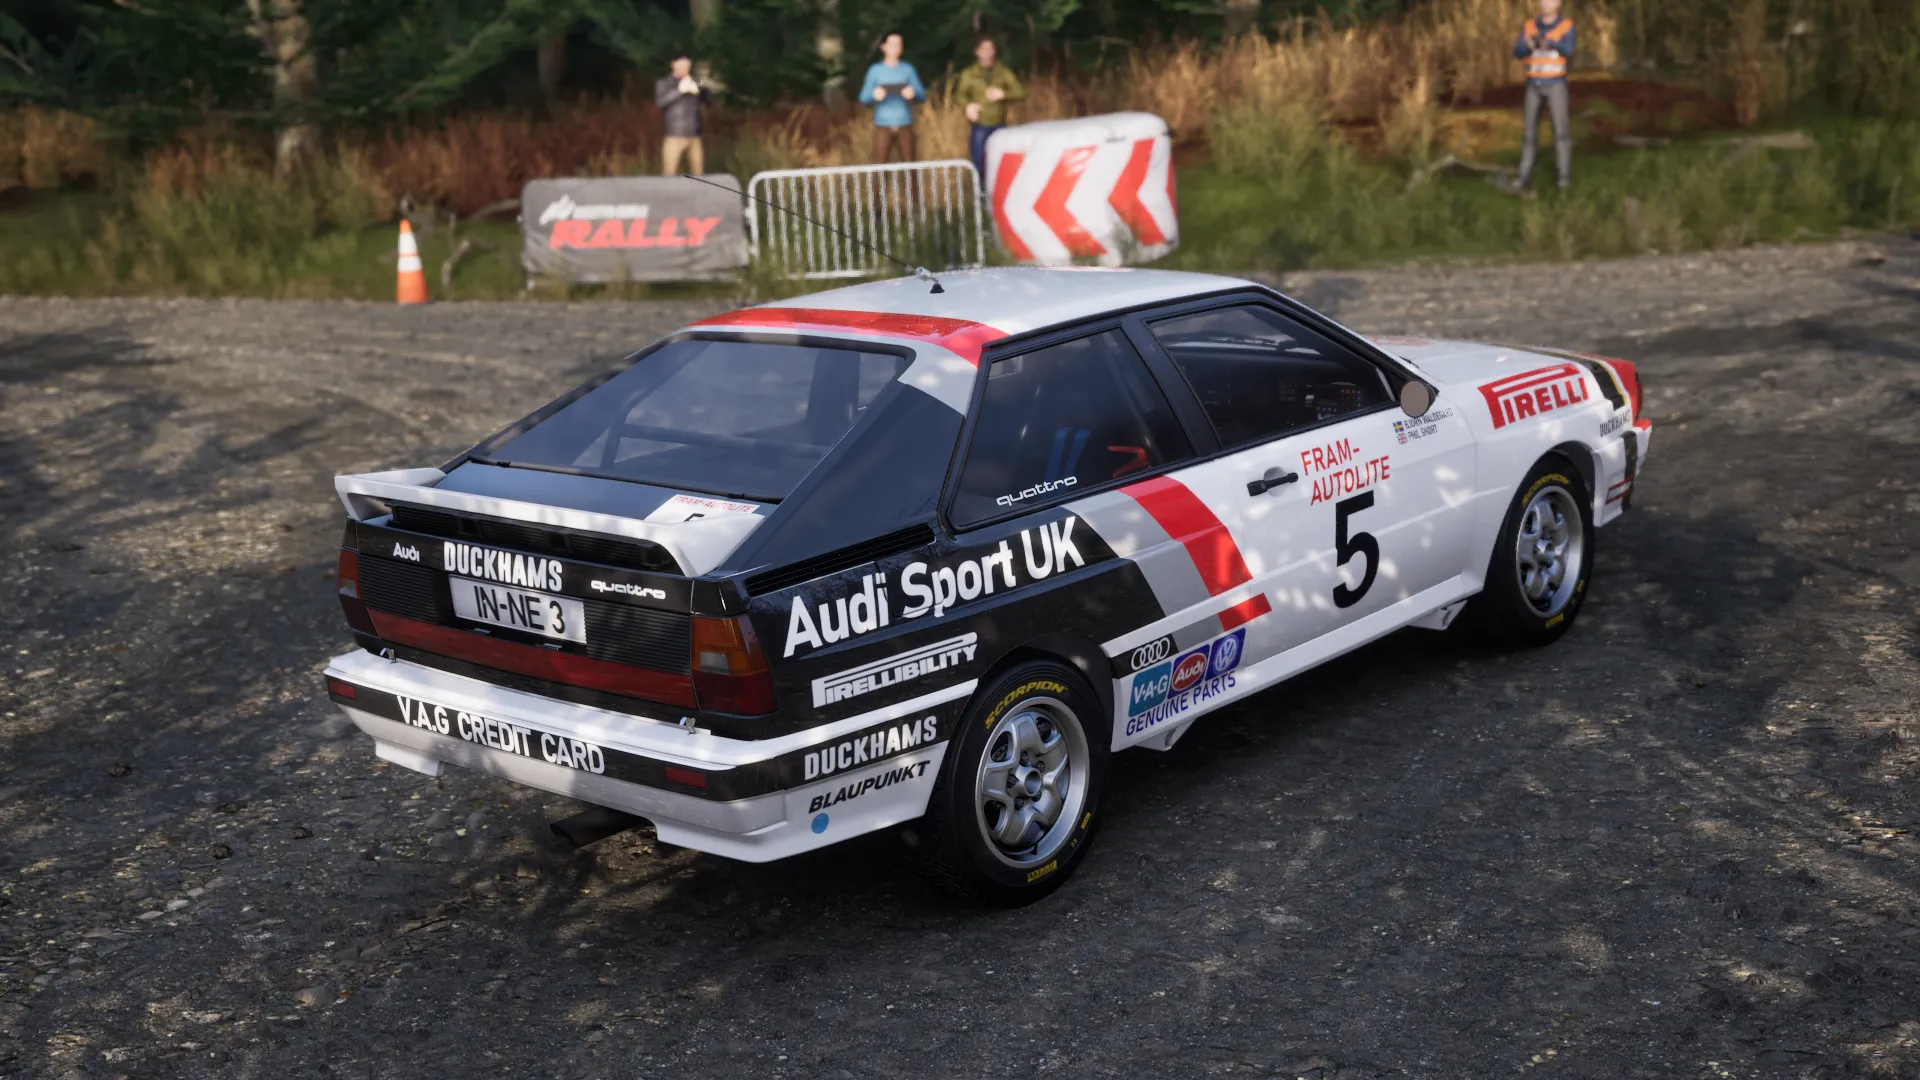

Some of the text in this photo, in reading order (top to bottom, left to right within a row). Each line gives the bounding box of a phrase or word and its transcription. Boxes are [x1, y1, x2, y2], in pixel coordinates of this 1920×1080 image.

[549, 216, 721, 248] RALLY
[1478, 363, 1589, 430] PIRELLI
[1300, 437, 1361, 476] FRAM-
[1310, 455, 1391, 506] AUTOLITE
[996, 475, 1078, 507] quattro
[393, 542, 420, 562] Audi
[443, 541, 563, 592] DUCKHAMS
[1332, 490, 1380, 609] 5
[473, 585, 566, 634] IN-NE 3
[590, 579, 666, 600] quattro
[783, 516, 1085, 658] Audi Sport UK
[811, 631, 978, 708] PIRELLIBILITY
[1174, 660, 1205, 685] Audi
[985, 681, 1064, 729] SCORPION
[1126, 670, 1236, 736] GENUINE PARTS
[397, 695, 605, 775] V.A.G CREDIT CARD
[804, 715, 937, 781] DUCKHAMS
[808, 760, 931, 814] BLAUPUNKT
